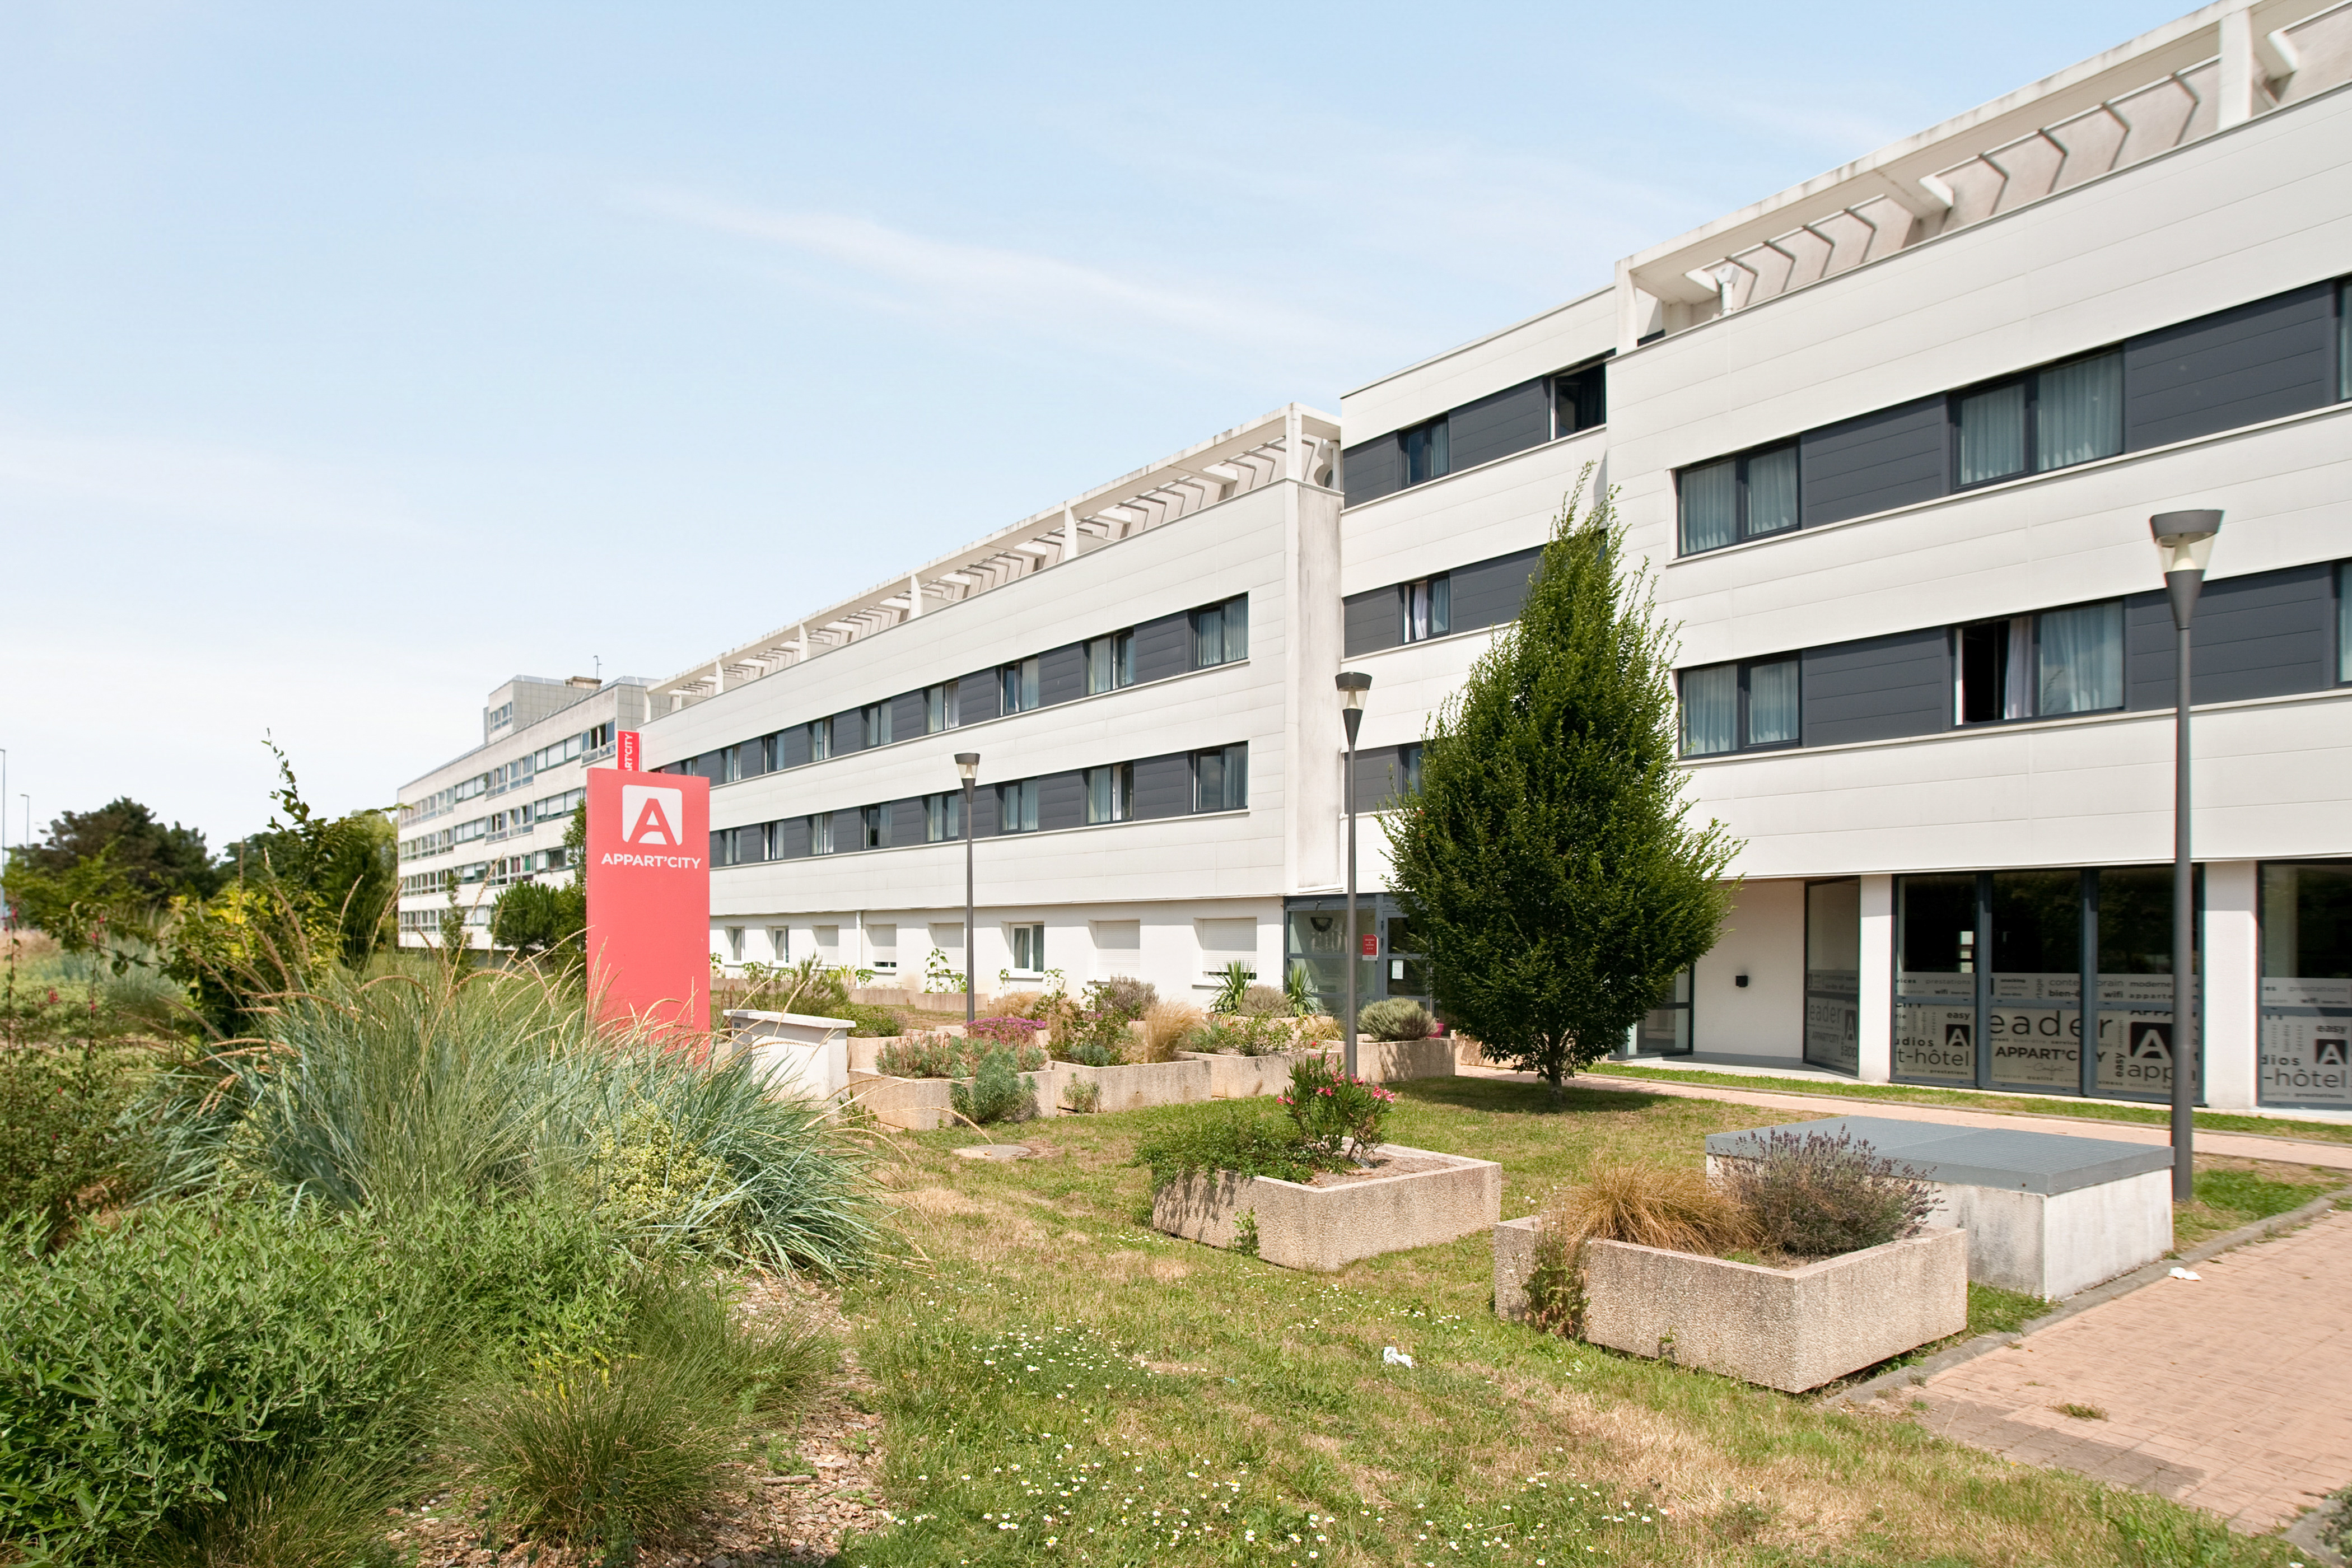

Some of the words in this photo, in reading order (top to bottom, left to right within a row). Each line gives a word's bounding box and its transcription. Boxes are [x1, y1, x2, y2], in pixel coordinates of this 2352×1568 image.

[601, 852, 701, 869] APPART'CITY
[1947, 1012, 1971, 1020] easy
[2316, 1025, 2348, 1034] easy
[2115, 1053, 2127, 1077] easy
